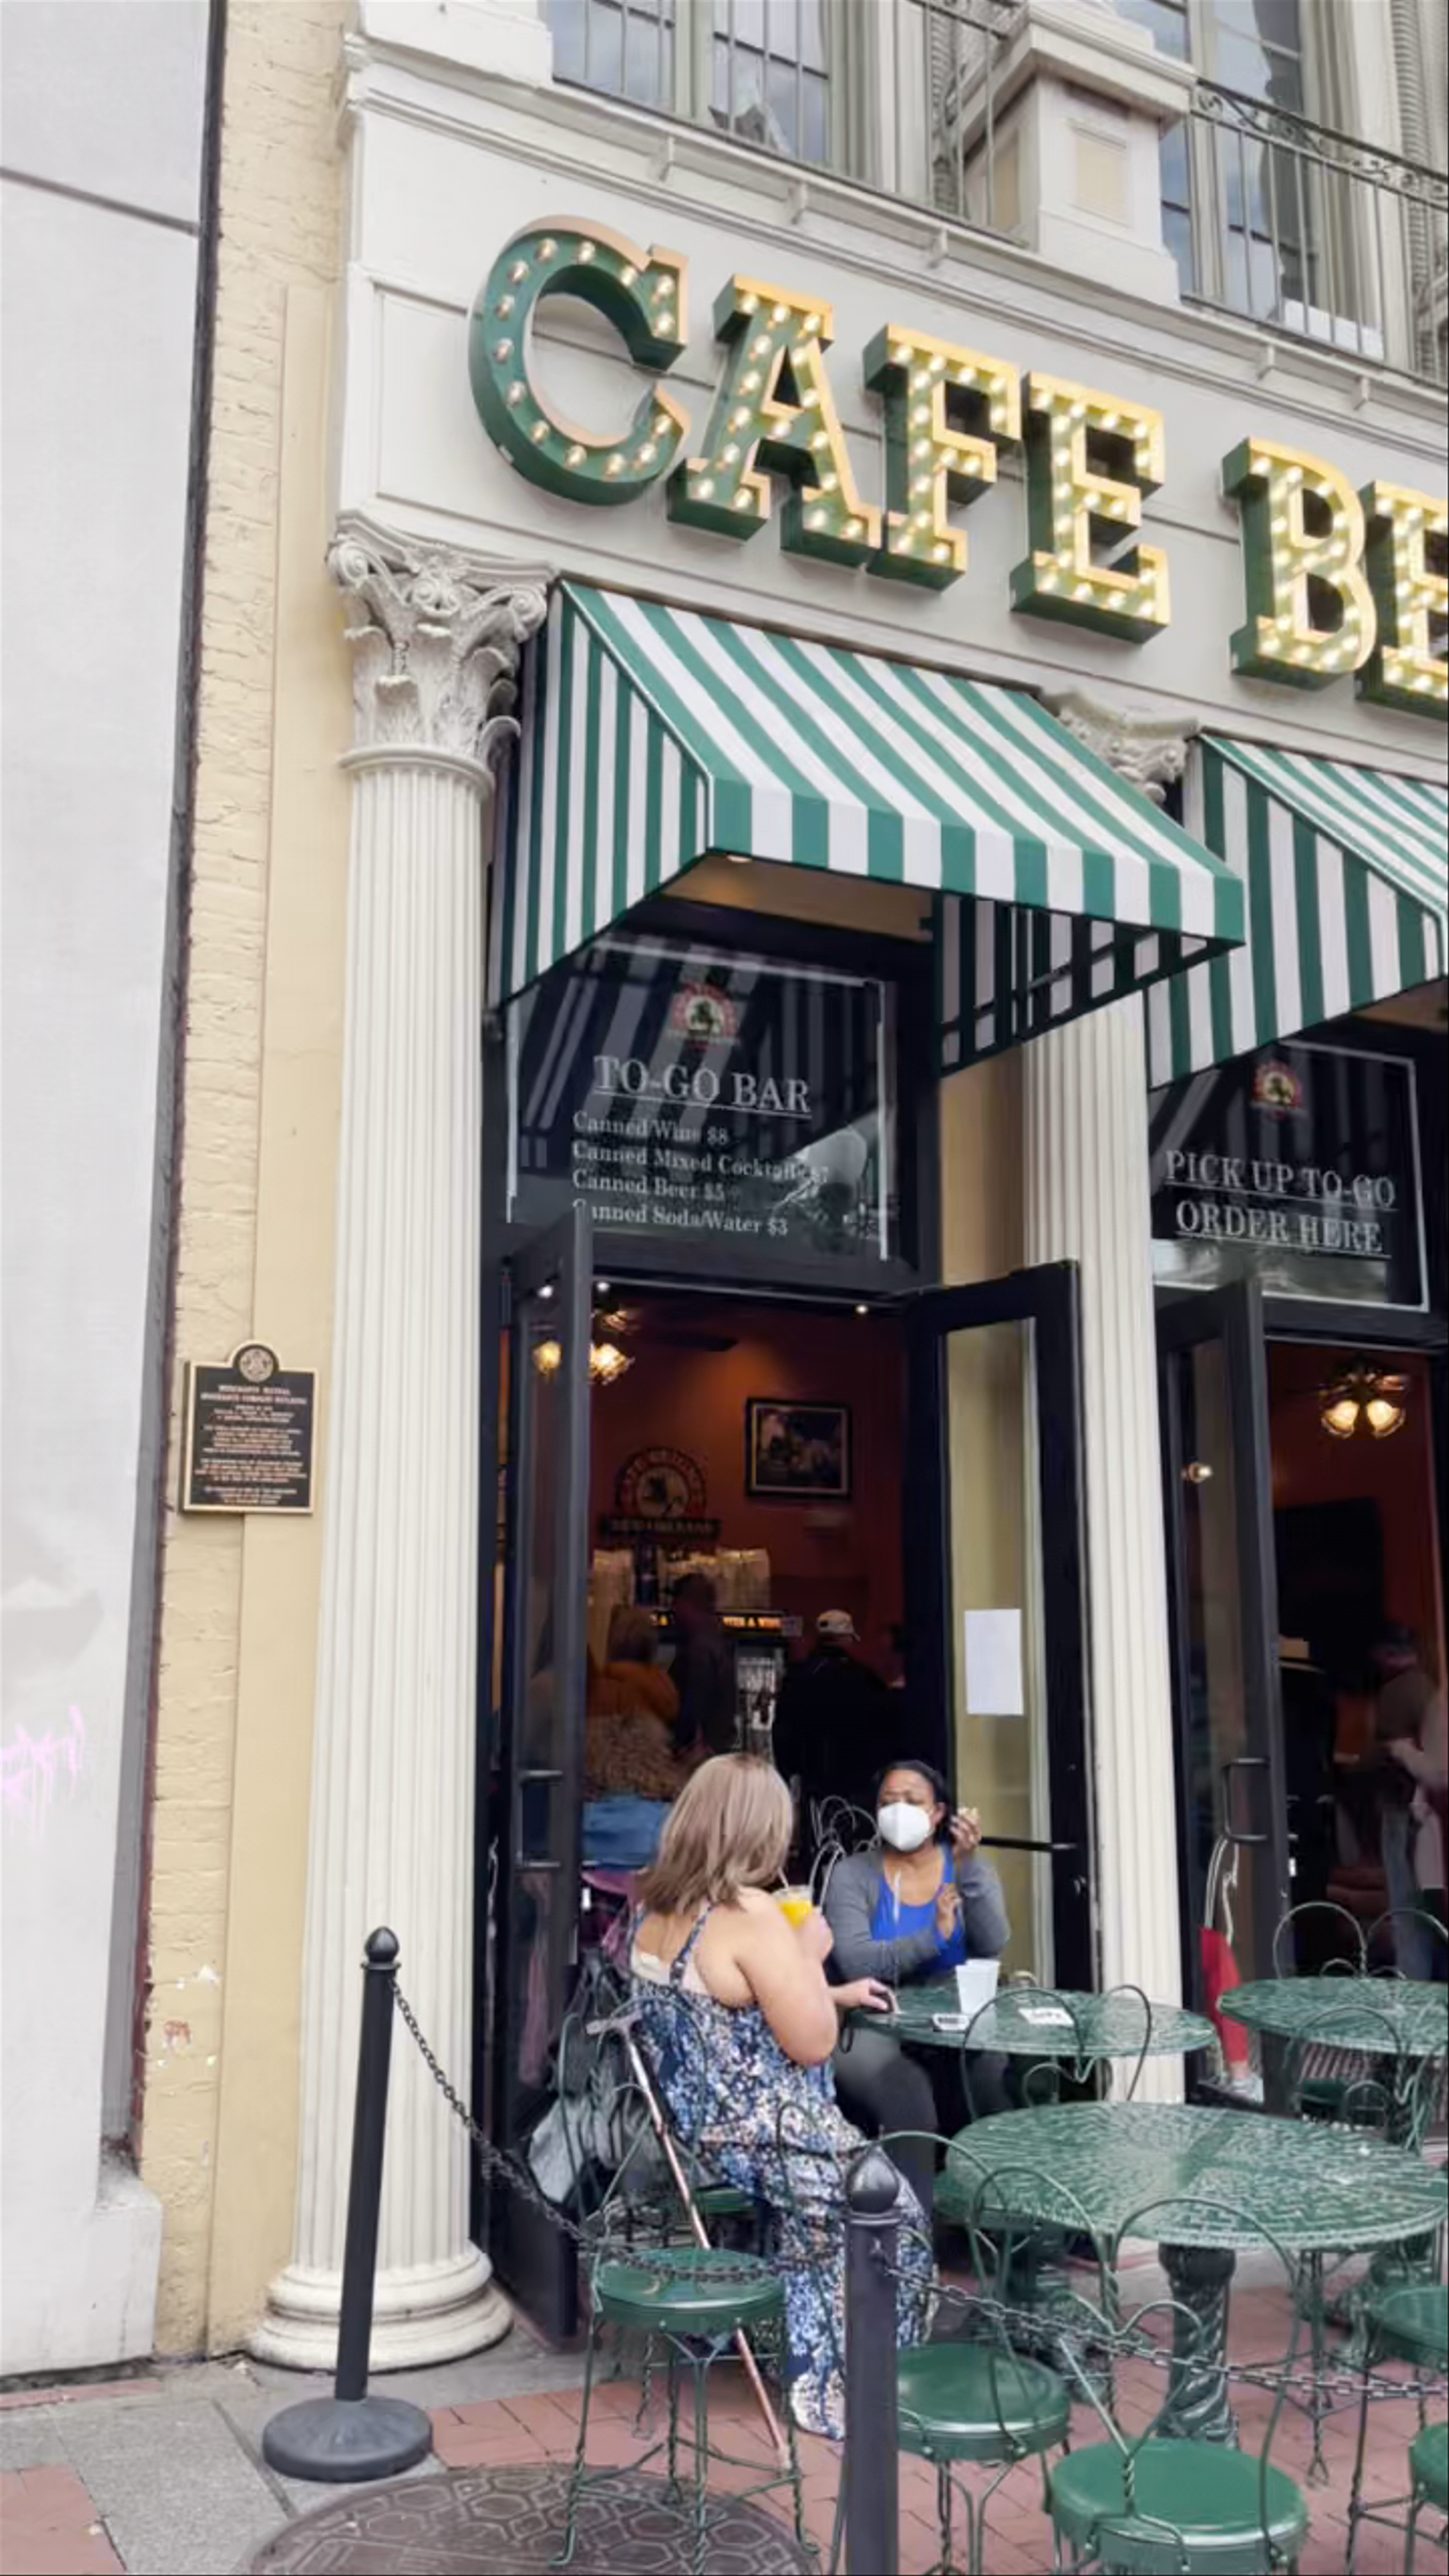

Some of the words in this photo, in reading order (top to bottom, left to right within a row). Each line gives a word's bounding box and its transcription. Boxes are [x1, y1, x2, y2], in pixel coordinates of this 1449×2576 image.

[469, 214, 1171, 644] CAFE
[594, 1055, 720, 1102] TO-GO
[732, 1073, 811, 1113] BAR
[573, 1110, 648, 1139] Canned
[572, 1139, 647, 1165] Canned
[654, 1148, 712, 1172] Mixed
[1166, 1150, 1243, 1188] PICK
[1252, 1159, 1294, 1193] UP
[1301, 1167, 1396, 1208] TO-GO
[572, 1168, 647, 1195] Canned
[654, 1177, 699, 1198] Beer
[1176, 1200, 1289, 1243] ORDER
[1299, 1213, 1383, 1253] HERE
